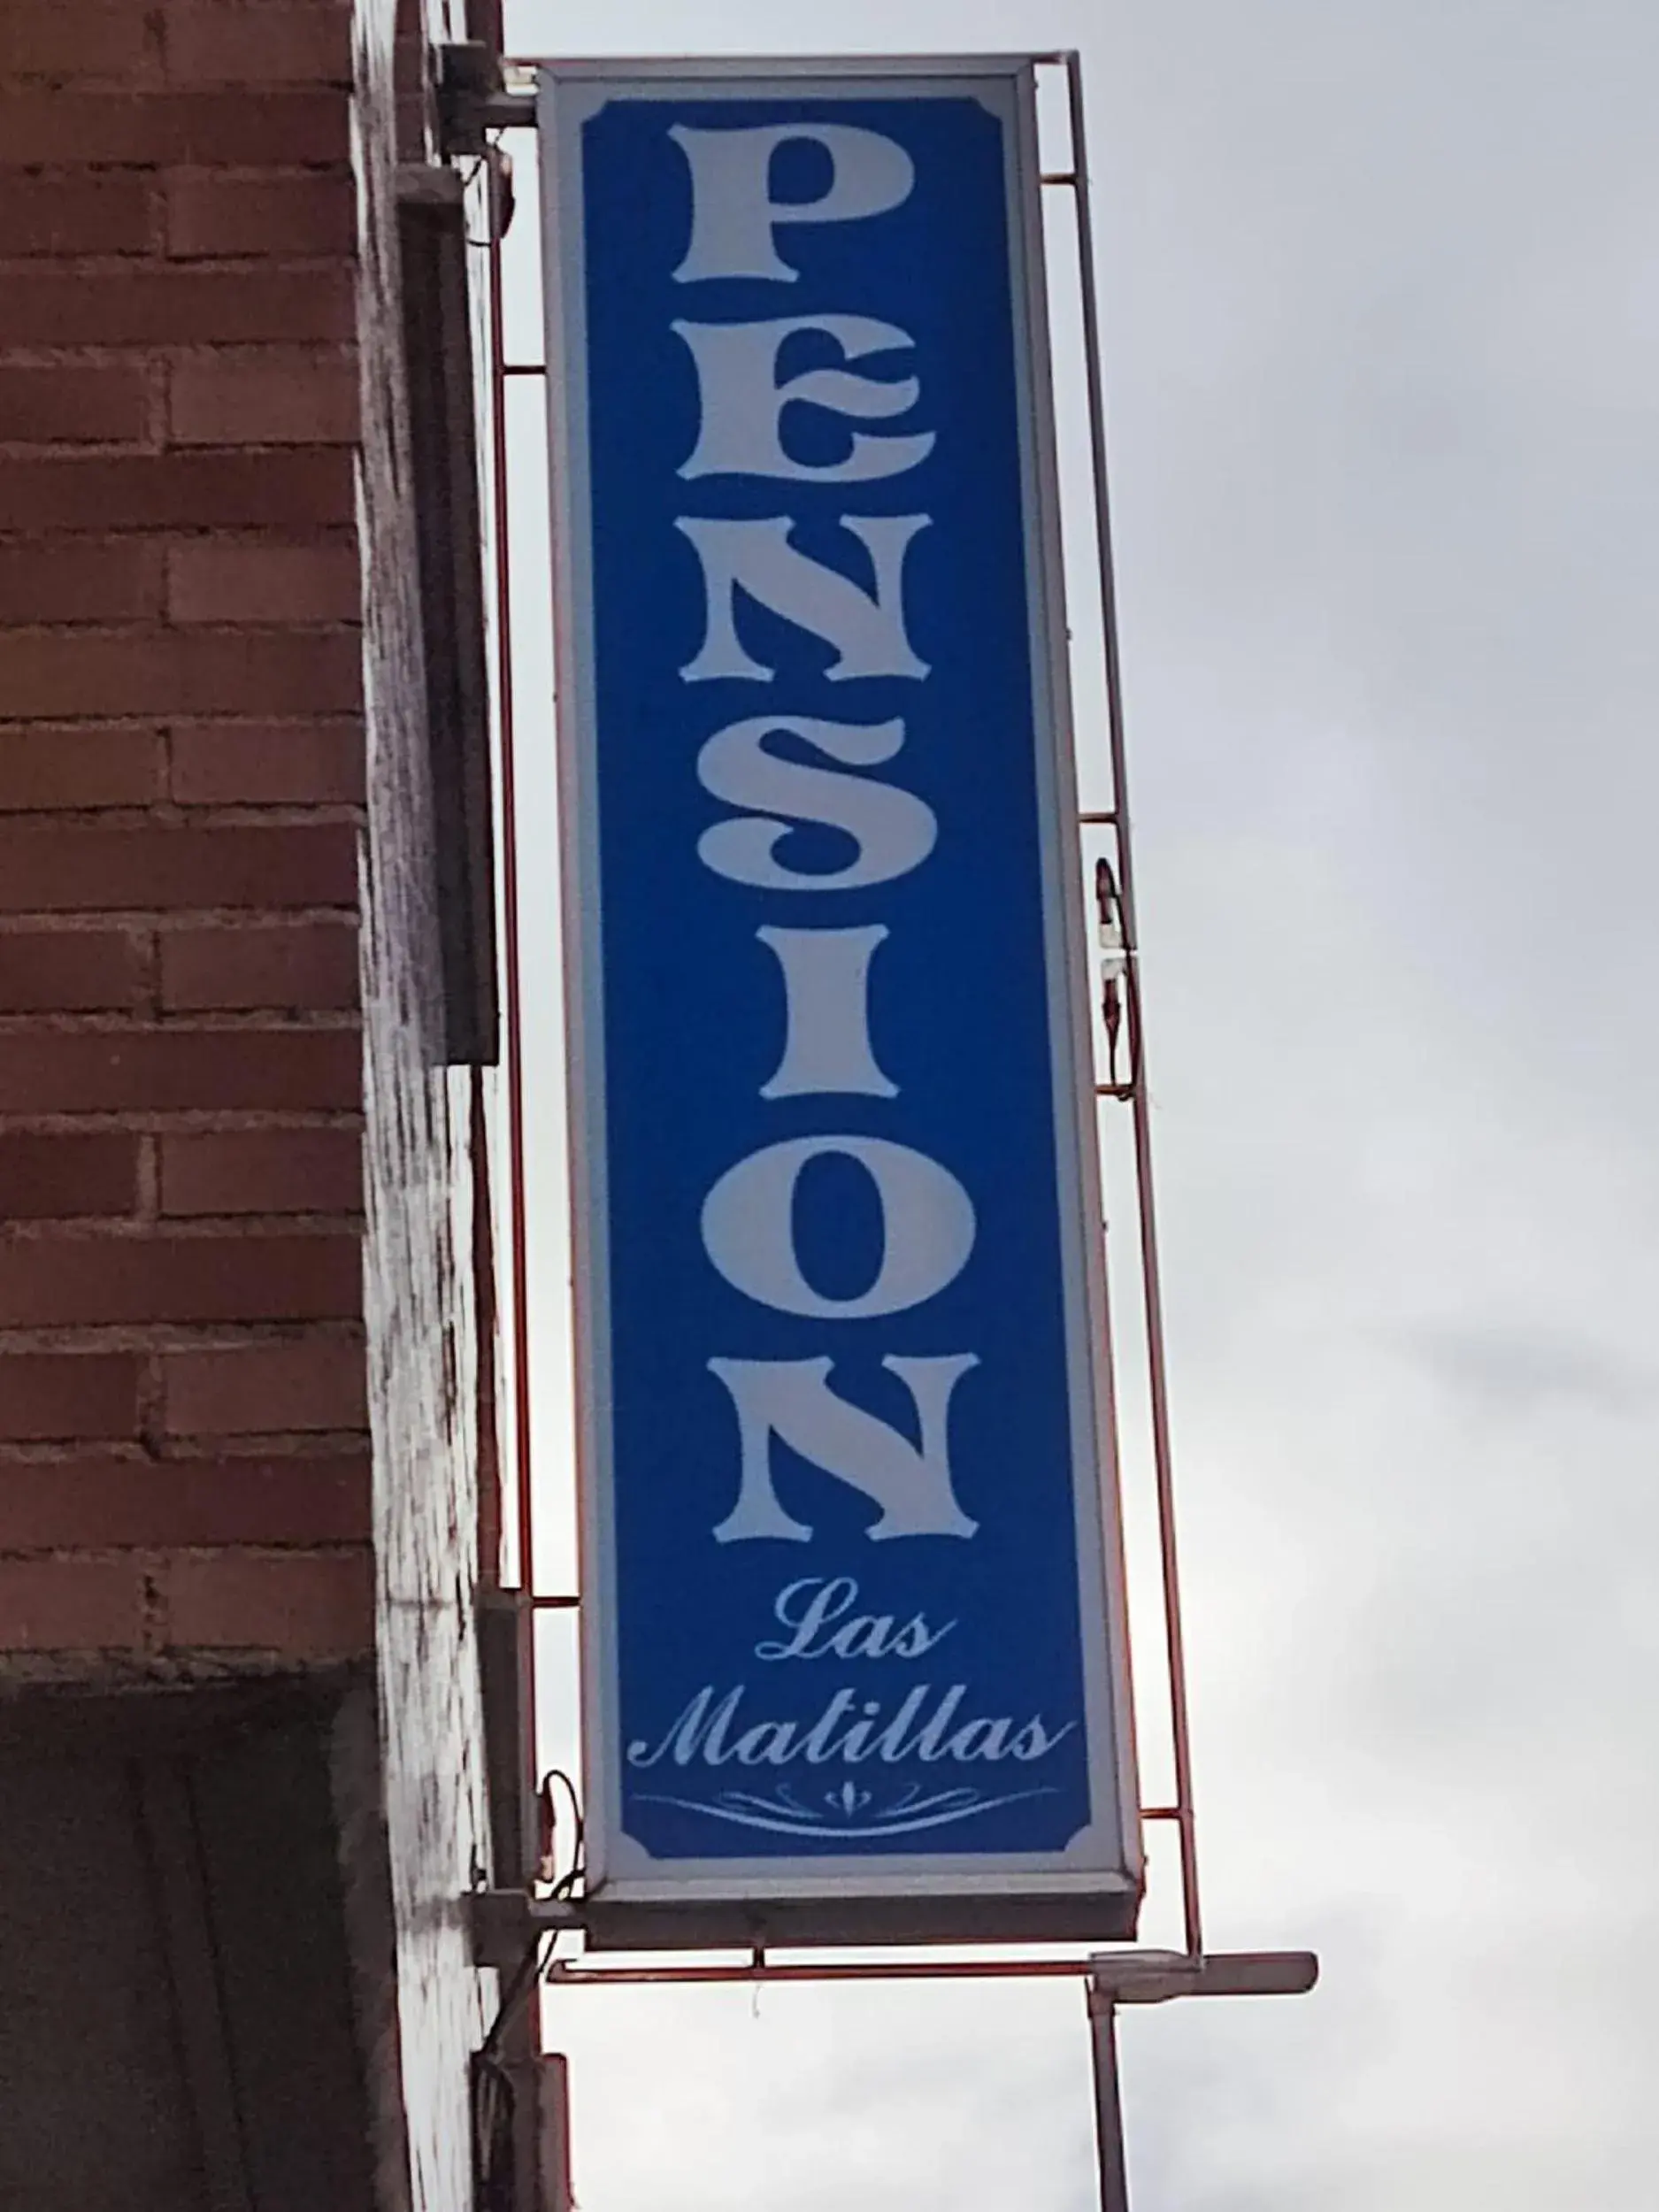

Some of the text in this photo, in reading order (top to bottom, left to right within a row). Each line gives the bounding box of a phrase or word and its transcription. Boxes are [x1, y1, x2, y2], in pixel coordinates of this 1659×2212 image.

[667, 121, 980, 1545] PENSION
[754, 1576, 959, 1661] Las
[626, 1684, 1079, 1769] Matillas
